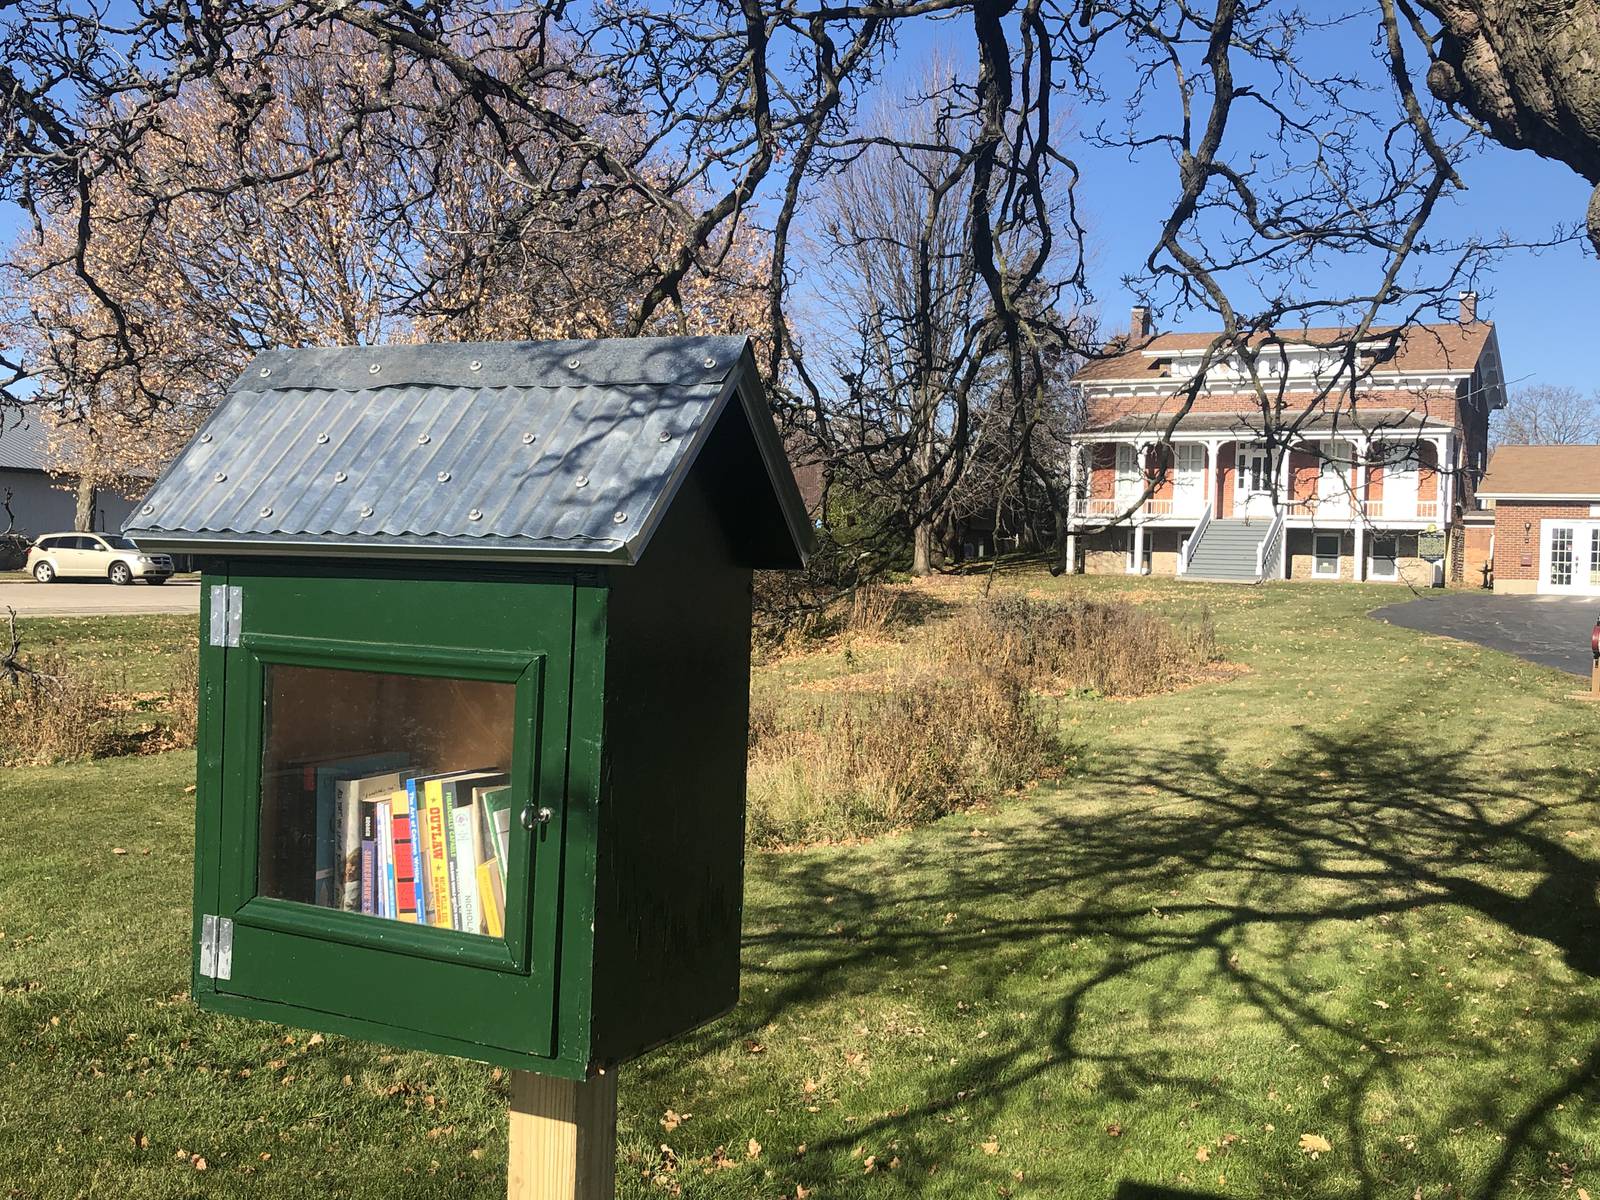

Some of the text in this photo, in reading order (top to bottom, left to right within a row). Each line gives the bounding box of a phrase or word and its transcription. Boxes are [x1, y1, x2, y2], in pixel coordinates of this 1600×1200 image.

[411, 828, 419, 855] Column
[430, 807, 443, 859] OUTLAW
[465, 895, 474, 933] NICHOLA
